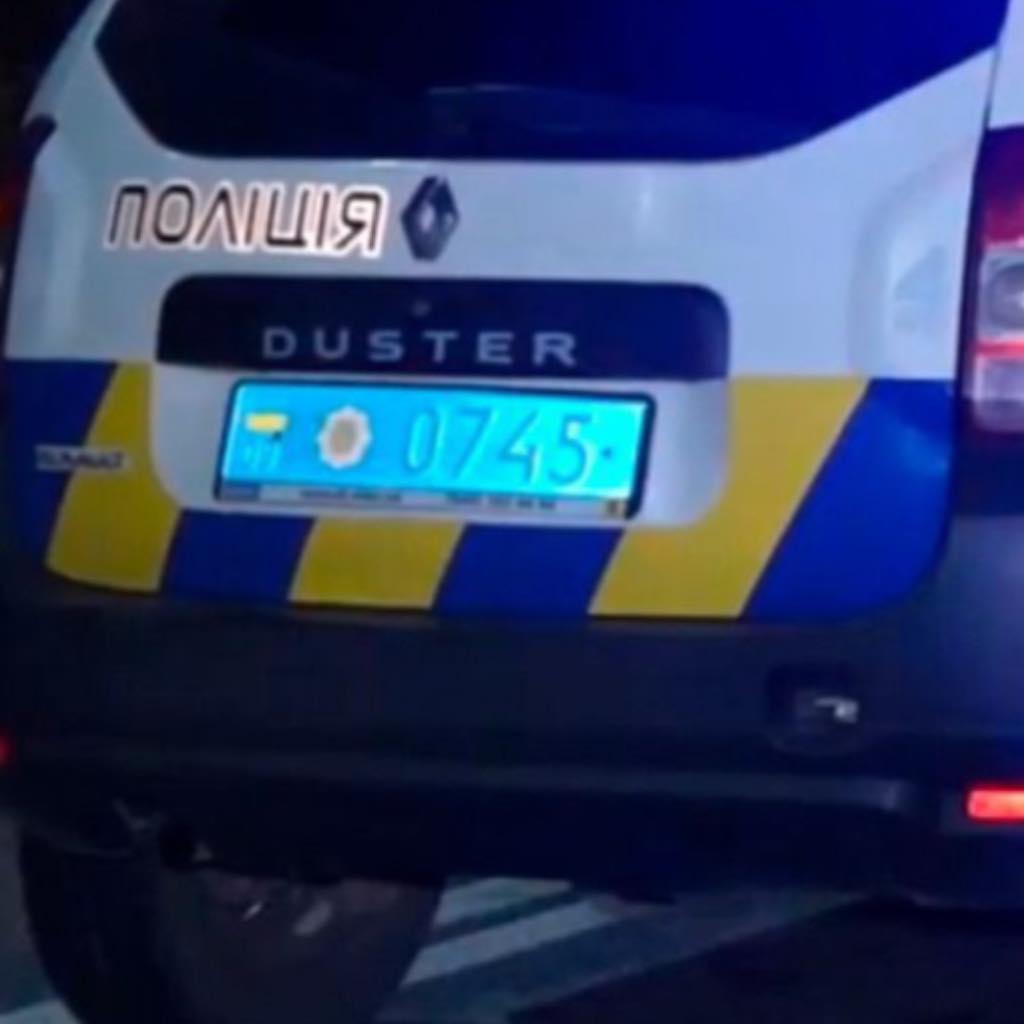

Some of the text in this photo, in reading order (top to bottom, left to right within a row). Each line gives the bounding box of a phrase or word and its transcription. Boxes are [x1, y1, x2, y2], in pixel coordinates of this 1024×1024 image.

[105, 180, 388, 256] ПОЛІЦІЯ
[261, 326, 578, 366] DUSTER
[404, 403, 598, 487] 0745
